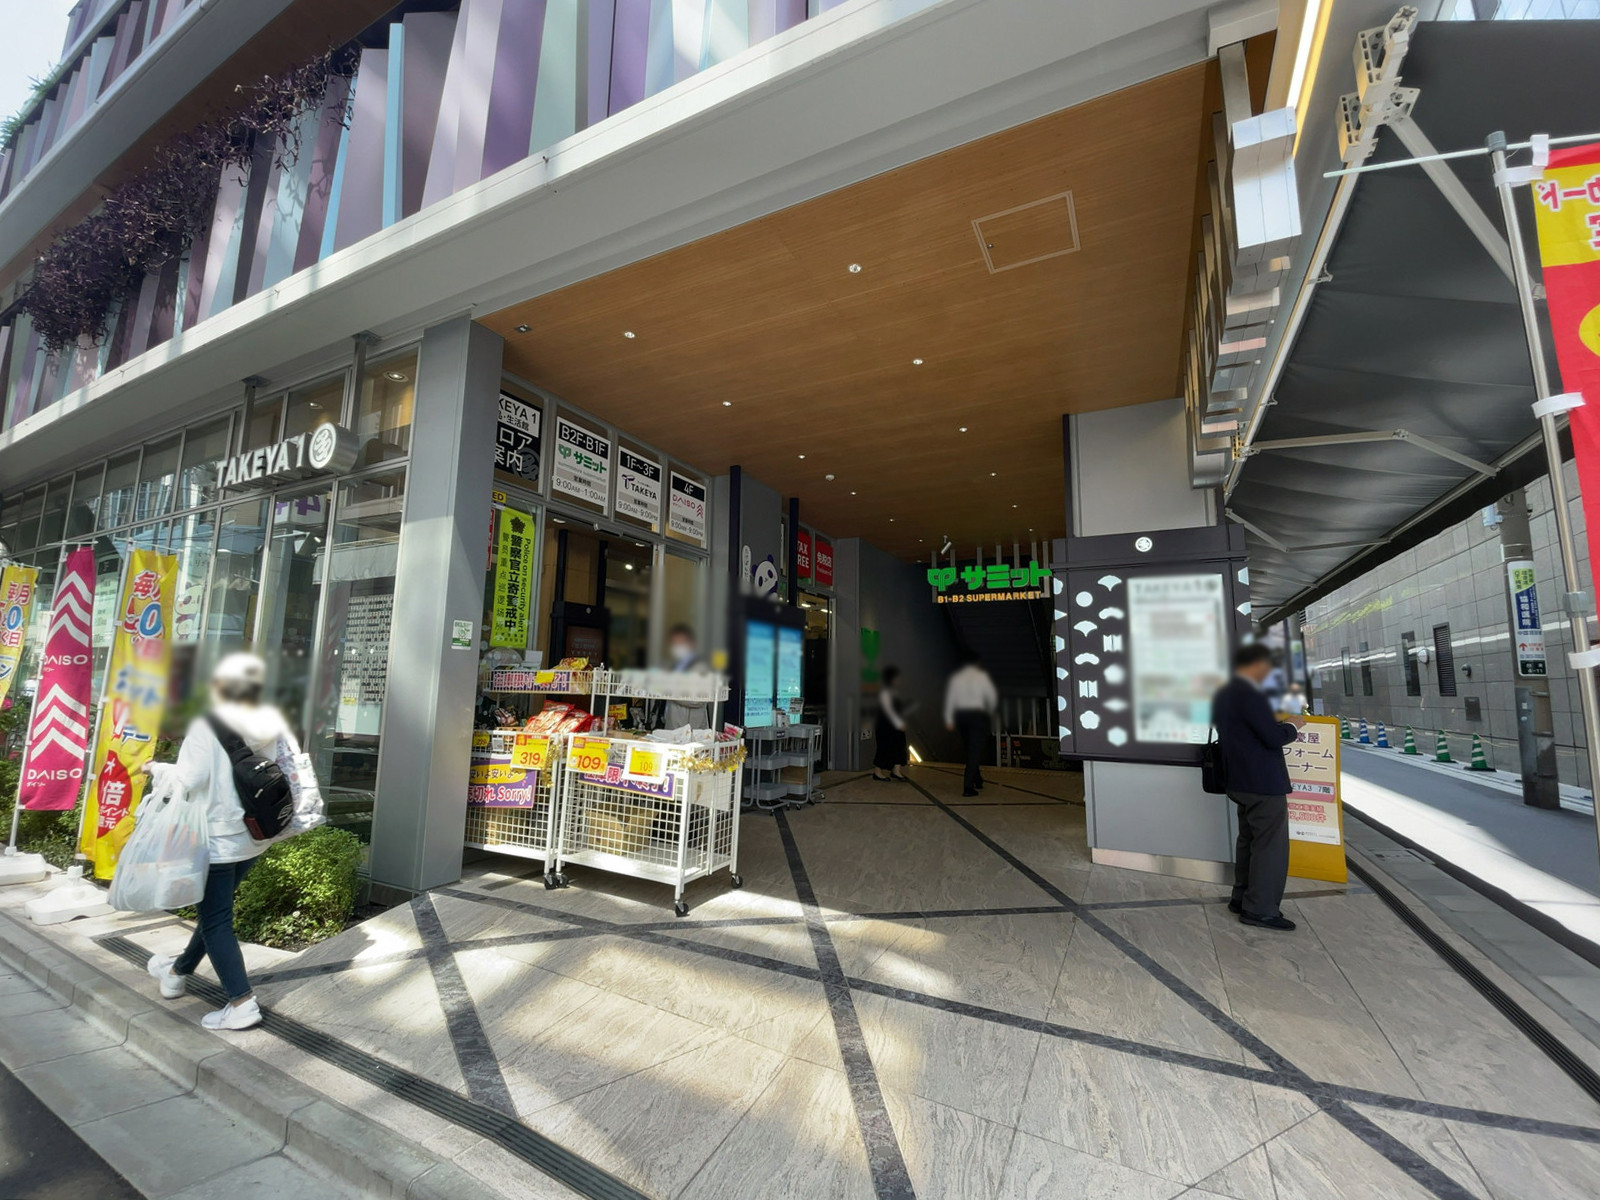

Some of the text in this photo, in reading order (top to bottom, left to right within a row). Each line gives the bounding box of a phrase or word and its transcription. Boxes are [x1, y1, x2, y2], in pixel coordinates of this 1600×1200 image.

[217, 432, 306, 489] TAKEYA 1
[573, 451, 607, 474] サミット
[631, 483, 657, 500] TAKEYA
[683, 482, 694, 495] 4F
[672, 494, 696, 510] DAISO
[960, 560, 1052, 590] サミット
[517, 537, 531, 633] Police on security alert
[966, 591, 1041, 602] SUPERMARKET
[44, 655, 88, 668] DAISO
[519, 751, 541, 766] 319
[577, 755, 601, 770] 109
[27, 768, 83, 781] DAISO
[639, 761, 653, 773] 109
[497, 784, 533, 804] Sorry!
